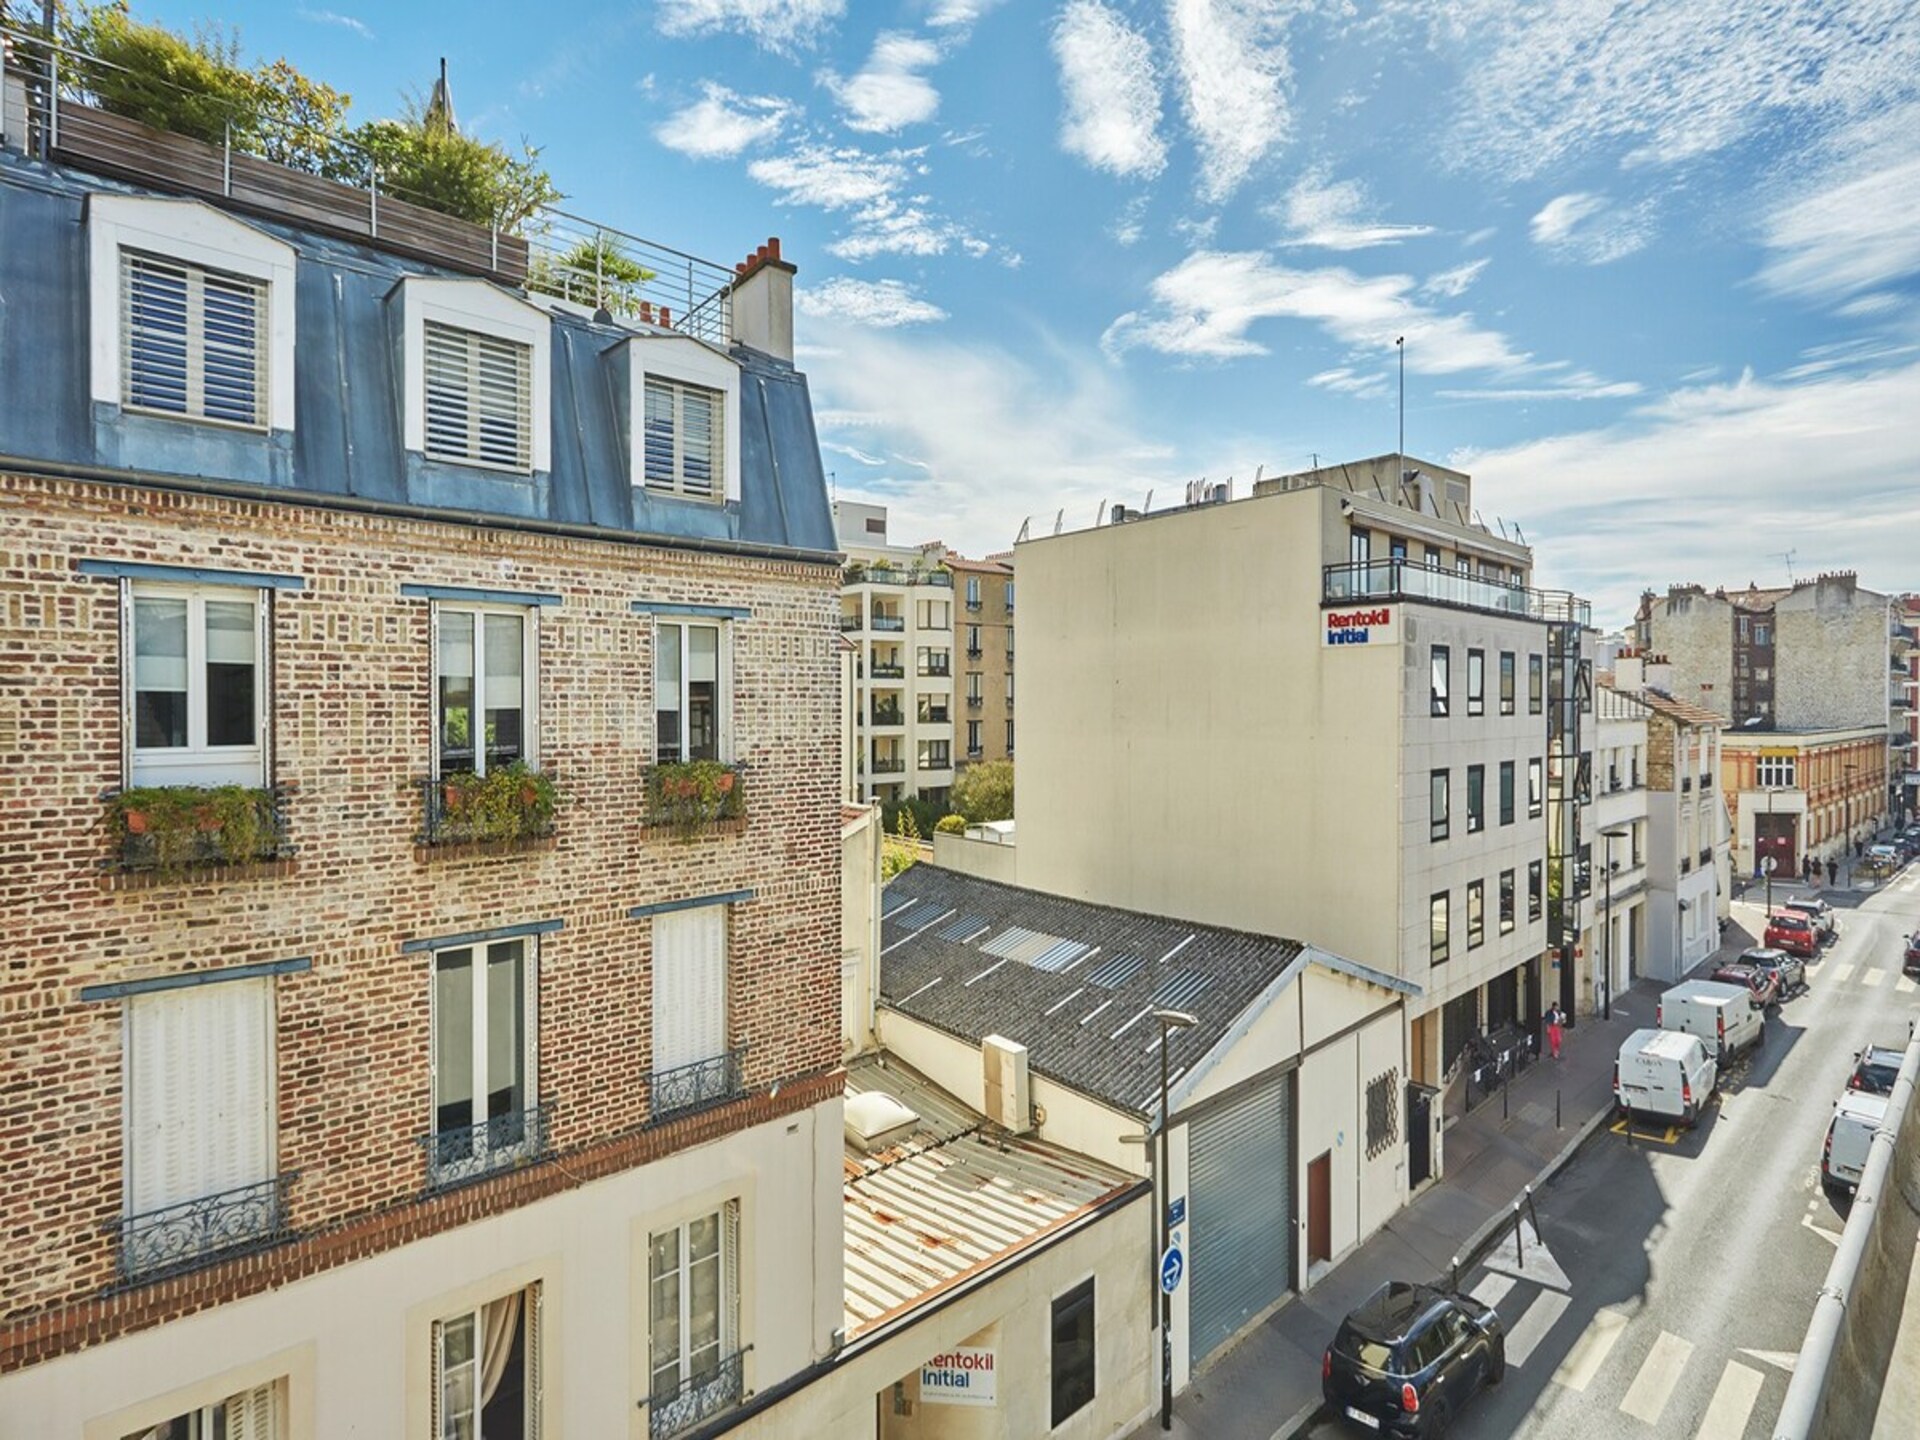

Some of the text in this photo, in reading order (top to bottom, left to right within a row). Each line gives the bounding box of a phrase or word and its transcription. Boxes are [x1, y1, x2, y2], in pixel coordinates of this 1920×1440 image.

[1328, 608, 1390, 628] Rentokil
[1328, 627, 1368, 645] Initial
[923, 1369, 969, 1388] Initial
